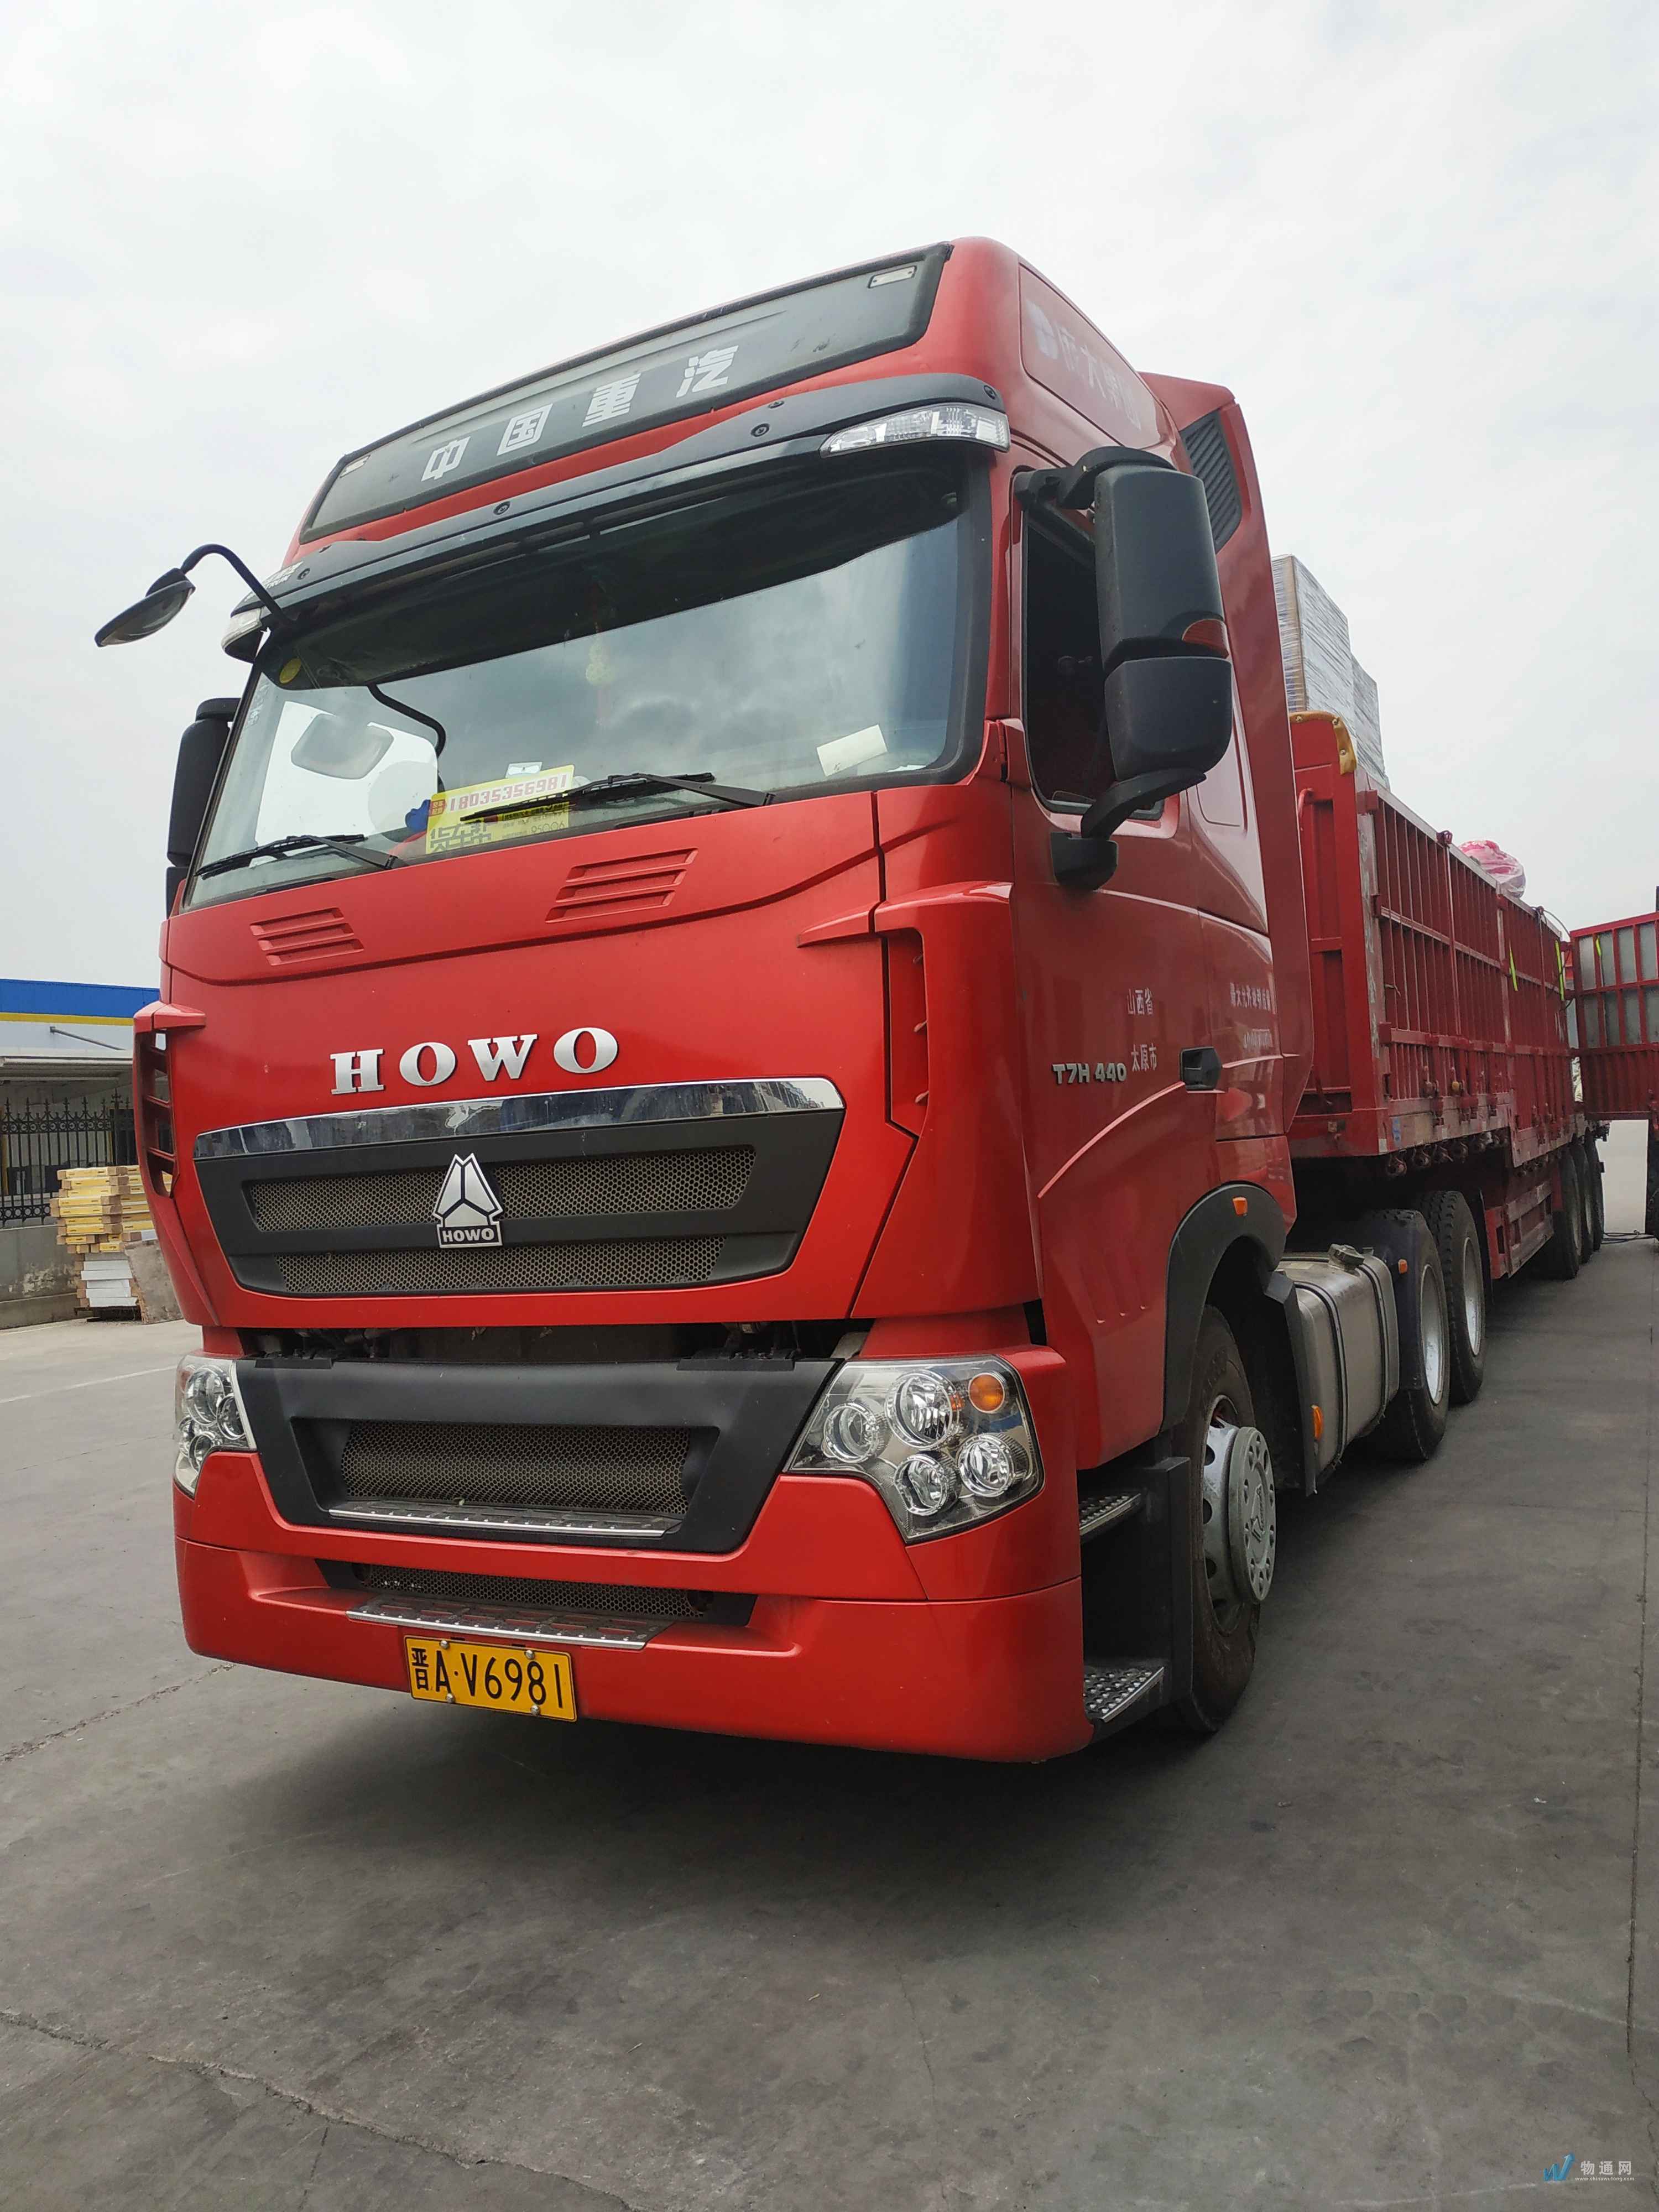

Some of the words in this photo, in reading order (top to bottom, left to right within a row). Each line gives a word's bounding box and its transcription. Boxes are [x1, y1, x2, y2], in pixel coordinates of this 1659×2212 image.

[420, 345, 739, 482] 中国重汽
[450, 774, 567, 811] 18035356981
[1127, 988, 1154, 1016] 山西省
[330, 1027, 618, 1095] HOWO
[1131, 1043, 1158, 1072] 太原市
[1052, 1063, 1090, 1085] T7H
[1095, 1062, 1128, 1082] 440
[442, 1228, 494, 1243] HOWO
